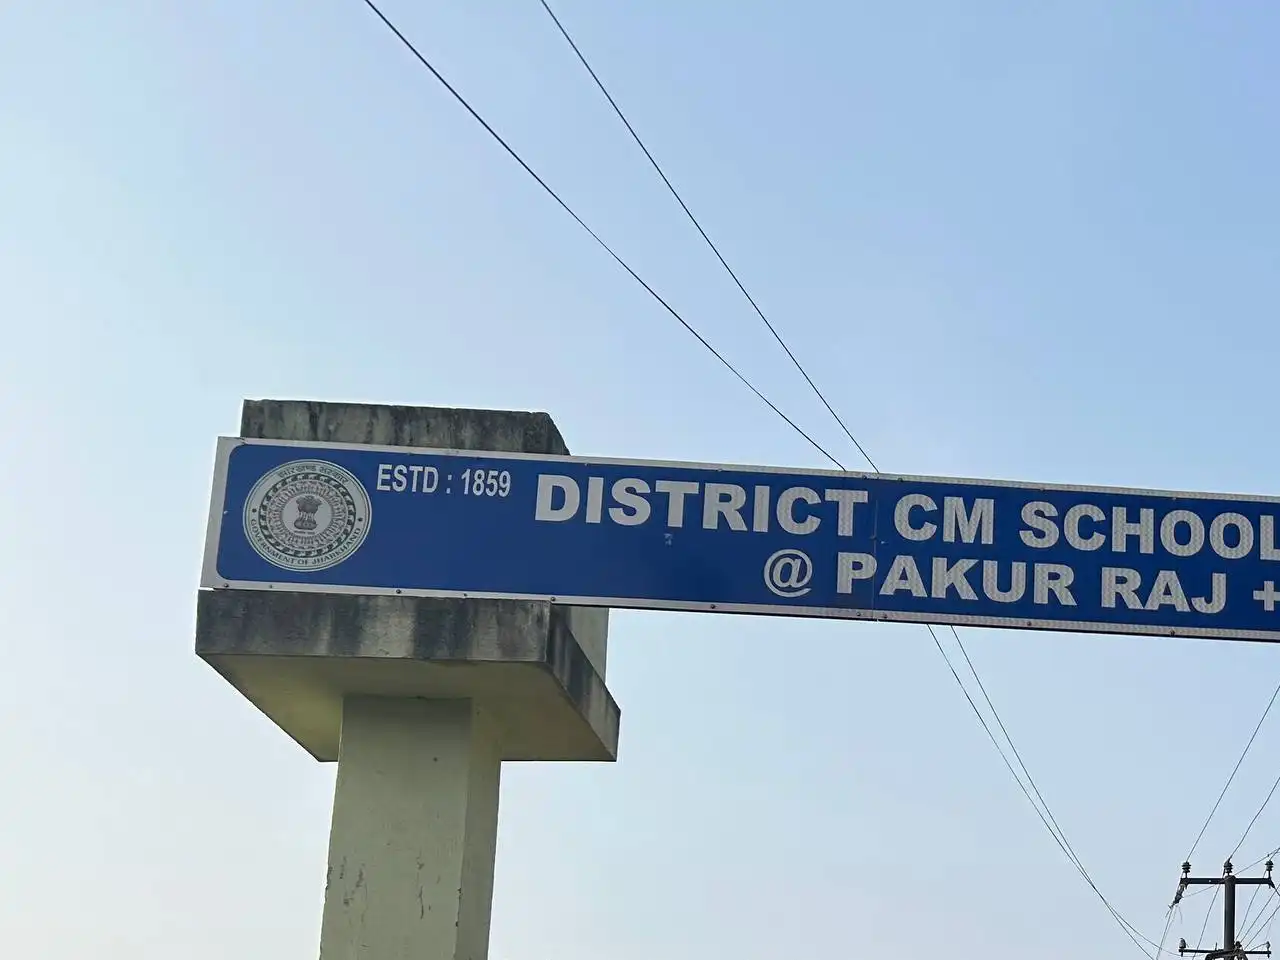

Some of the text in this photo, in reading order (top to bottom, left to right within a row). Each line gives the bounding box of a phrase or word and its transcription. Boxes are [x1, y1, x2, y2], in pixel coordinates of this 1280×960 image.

[376, 463, 439, 493] ESTD
[461, 468, 511, 498] 1859
[534, 474, 869, 537] DISTRICT
[894, 493, 995, 545] CM
[250, 518, 362, 566] GOVERNMENT OF JHARKHAND
[763, 548, 813, 598] @
[836, 551, 1077, 606] PAKUR
[1101, 566, 1227, 614] RAJ
